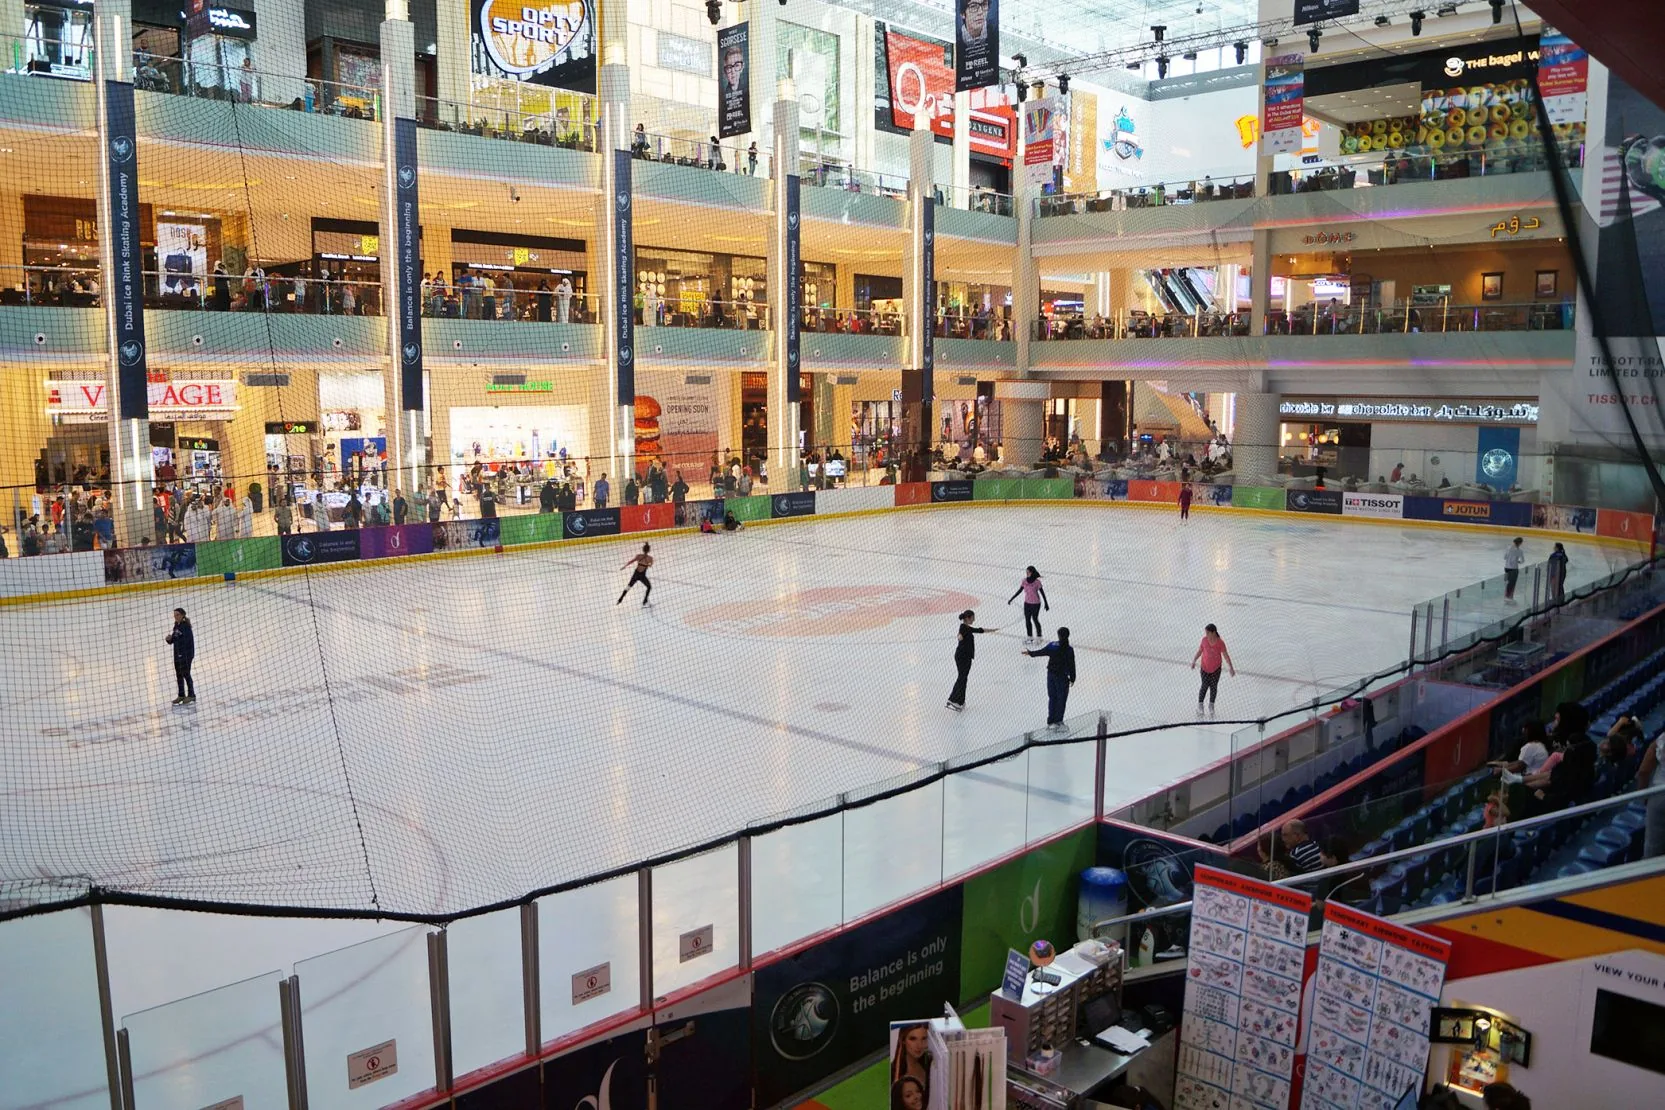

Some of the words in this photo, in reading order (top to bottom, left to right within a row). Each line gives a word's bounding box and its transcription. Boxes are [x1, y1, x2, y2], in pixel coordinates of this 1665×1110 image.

[493, 17, 567, 45] SPORT
[523, 7, 579, 32] OPTY
[1466, 58, 1488, 69] THE
[1489, 51, 1522, 66] bagel
[969, 121, 1003, 136] OXYGENE
[118, 172, 129, 218] Academy
[403, 202, 413, 246] beginning
[120, 220, 131, 258] Skating
[619, 218, 628, 254] Academy
[404, 249, 412, 263] the
[121, 261, 131, 282] Rink
[404, 265, 413, 284] only
[620, 255, 629, 284] Skating
[123, 284, 132, 299] Ice
[123, 301, 133, 330] Dubai
[405, 295, 414, 330] Balance
[1589, 368, 1638, 377] LIMTED
[81, 384, 222, 407] VAGE
[667, 405, 692, 414] OPENING
[693, 404, 709, 414] SOON
[1352, 403, 1409, 416] chocolate
[1410, 404, 1431, 417] bar
[1361, 499, 1400, 508] TISSOT
[1455, 506, 1488, 516] JOTUN
[850, 958, 903, 993] Balance
[907, 950, 917, 965] is
[921, 936, 948, 959] only
[1594, 963, 1623, 977] VIEW
[1627, 971, 1659, 986] YOUR
[853, 993, 876, 1013] the
[880, 959, 944, 1000] beginning
